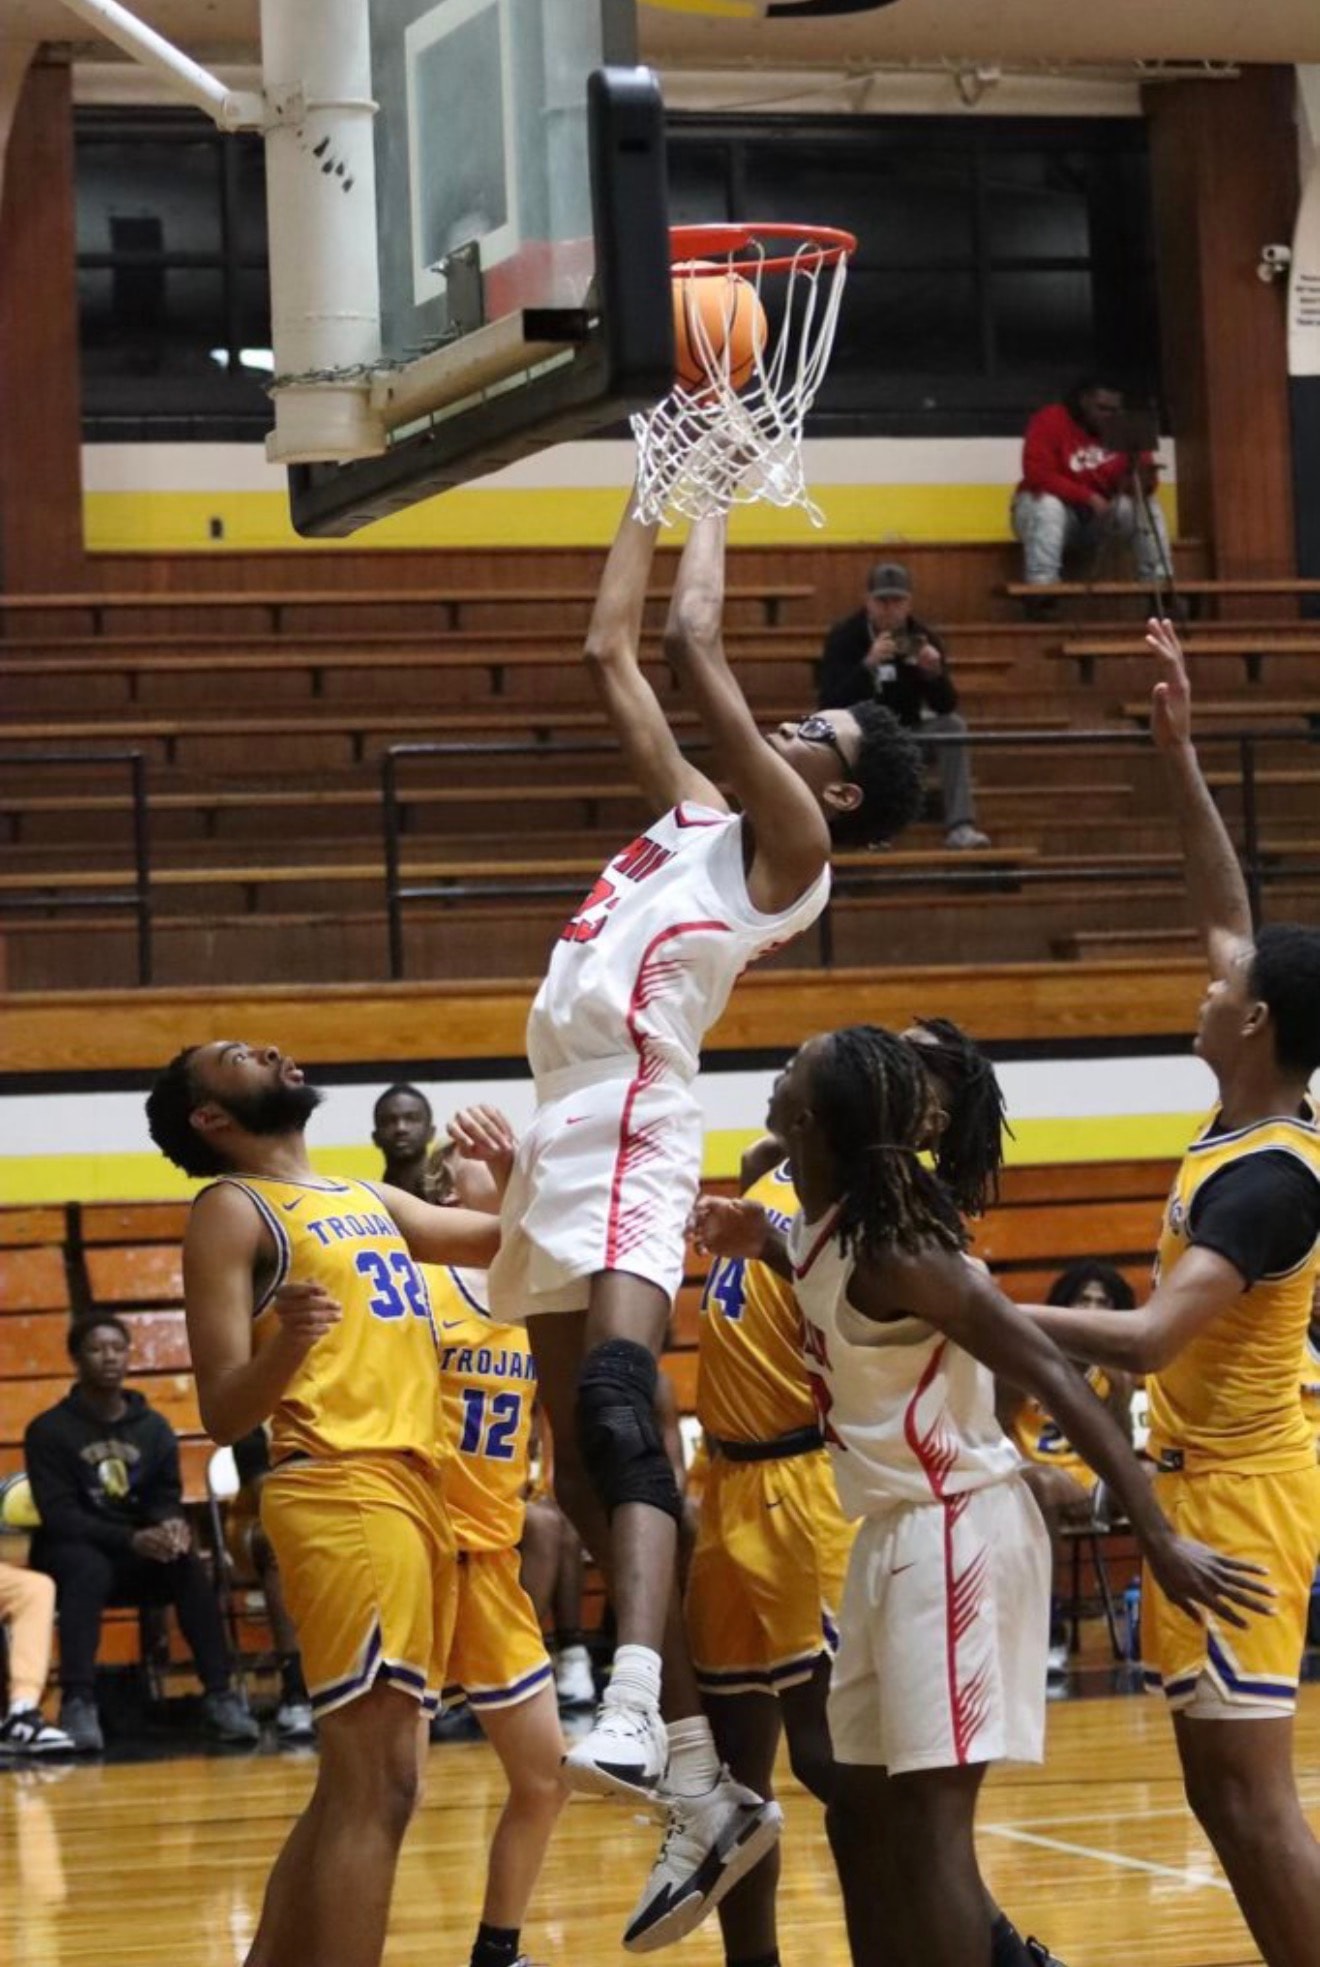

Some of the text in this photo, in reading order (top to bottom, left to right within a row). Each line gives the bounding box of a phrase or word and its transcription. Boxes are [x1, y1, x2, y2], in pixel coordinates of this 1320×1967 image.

[354, 1250, 430, 1319] 32
[701, 1255, 746, 1320] 14
[459, 1387, 522, 1460] 12
